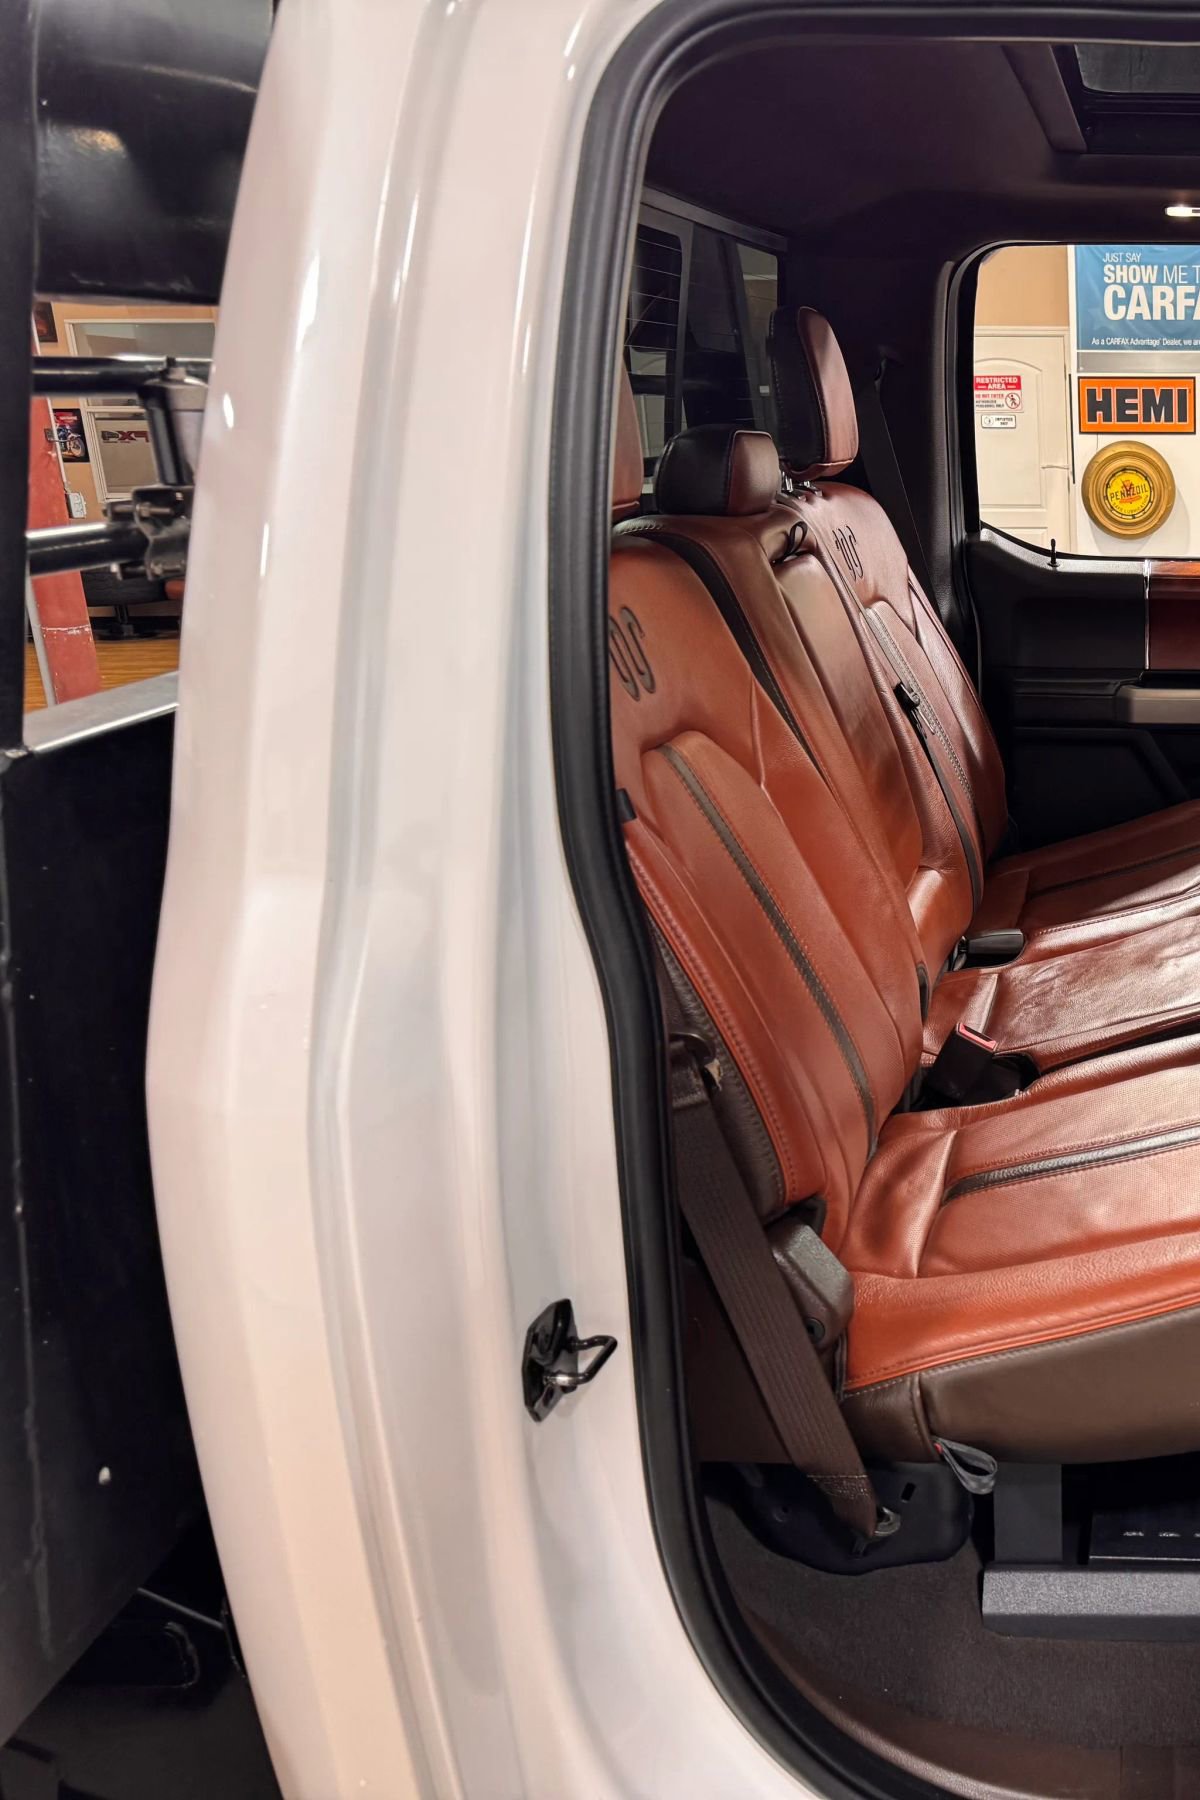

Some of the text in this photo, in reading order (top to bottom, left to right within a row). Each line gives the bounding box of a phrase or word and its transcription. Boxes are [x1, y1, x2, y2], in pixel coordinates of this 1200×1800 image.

[1102, 252, 1142, 263] JUST SAY
[1103, 264, 1158, 284] SHOW
[1163, 265, 1188, 284] ME
[1091, 337, 1100, 346] As
[1105, 337, 1129, 346] CARFAX
[975, 376, 1018, 384] RESTRICTED
[987, 383, 1006, 391] AREA
[1086, 387, 1189, 424] HEMI
